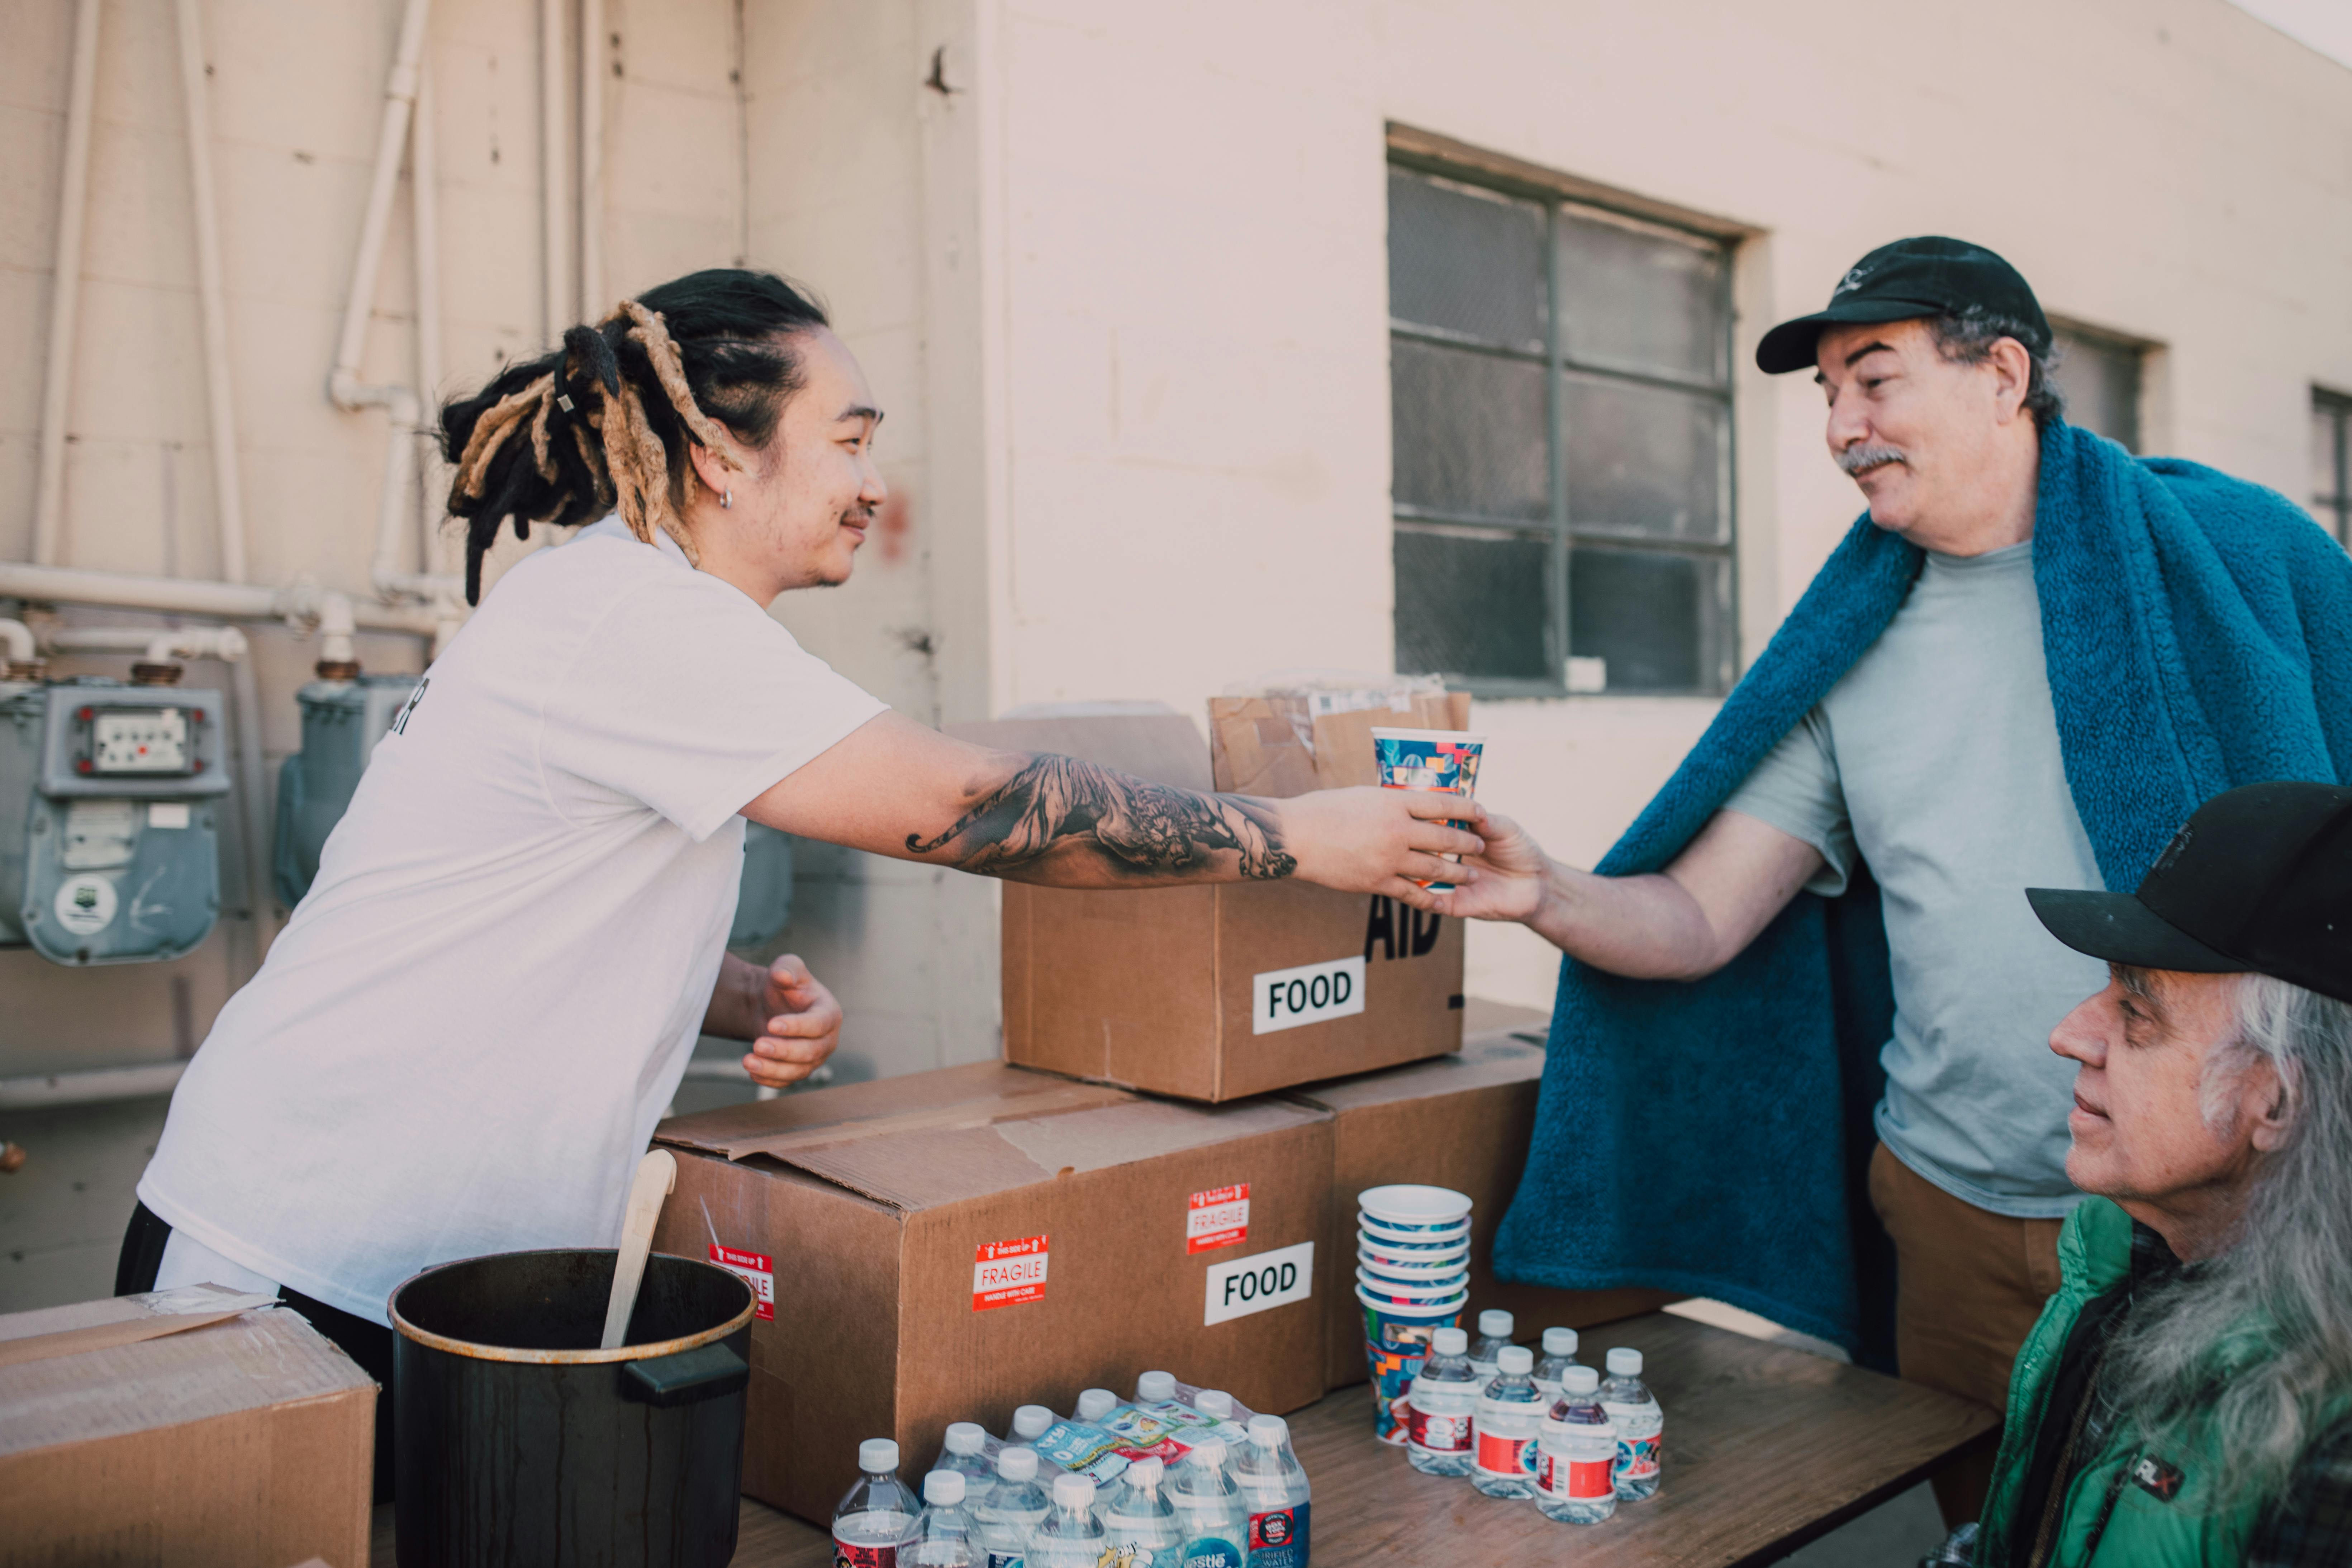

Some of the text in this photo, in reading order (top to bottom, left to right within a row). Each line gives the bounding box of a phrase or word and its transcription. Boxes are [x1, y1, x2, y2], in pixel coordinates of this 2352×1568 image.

[1364, 893, 1442, 964] AID
[1270, 971, 1351, 1018] FOOD
[1193, 1207, 1244, 1231] FRAGILE
[982, 1261, 1041, 1286] FRAGILE
[1225, 1262, 1297, 1306] FOOD
[984, 1291, 1006, 1302] HANDLE
[1007, 1289, 1020, 1298] WITH
[1020, 1287, 1035, 1296] CARE
